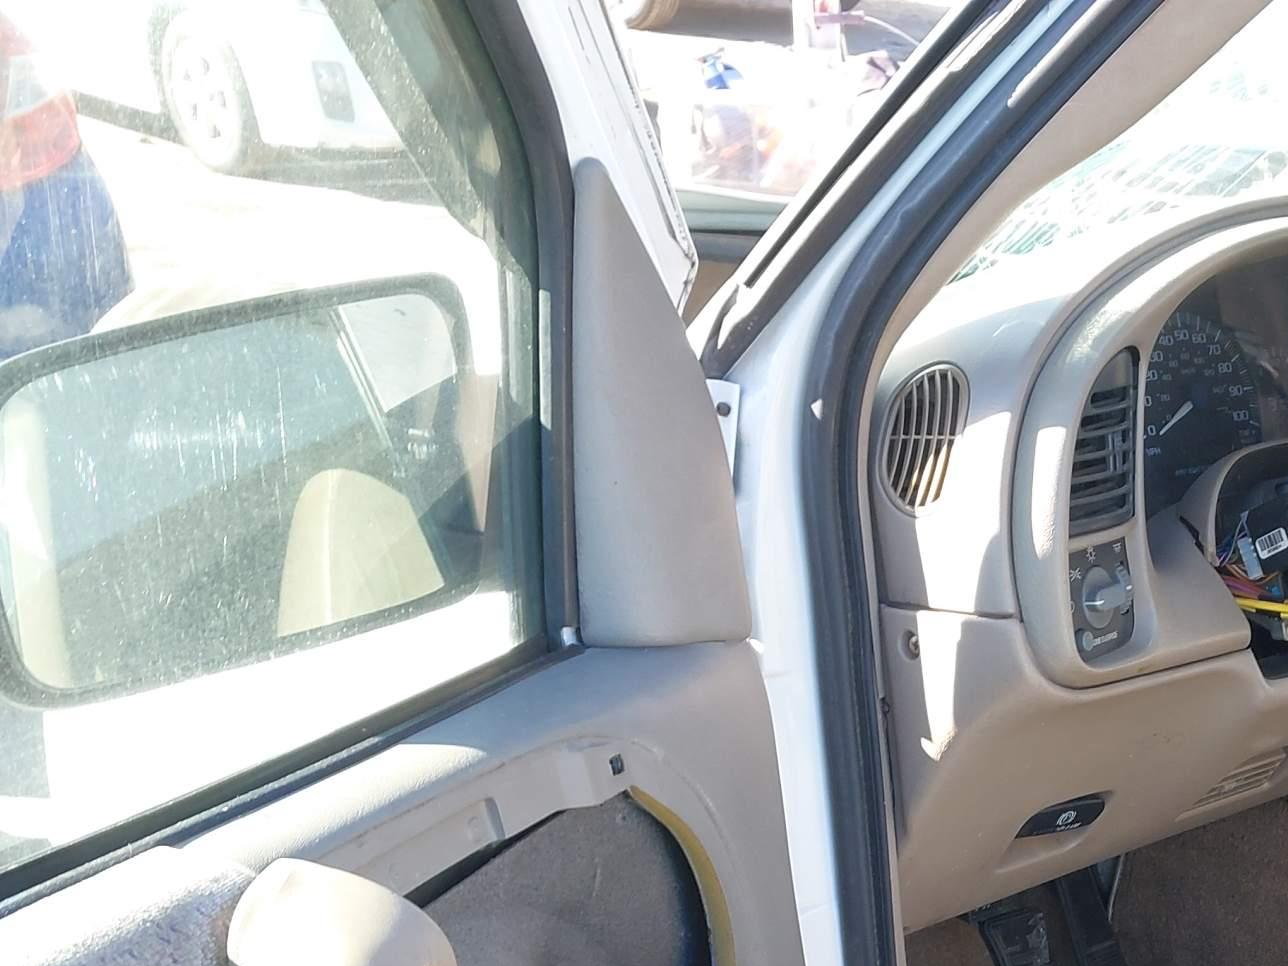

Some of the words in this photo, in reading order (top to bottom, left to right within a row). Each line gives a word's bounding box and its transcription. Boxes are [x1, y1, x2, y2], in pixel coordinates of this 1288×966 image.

[1159, 335, 1173, 345] 40
[1174, 329, 1189, 340] 50
[1191, 332, 1206, 344] 60
[1207, 344, 1221, 356] 70
[1217, 362, 1232, 373] 80
[1228, 384, 1243, 396] 90
[1232, 410, 1249, 421] 100
